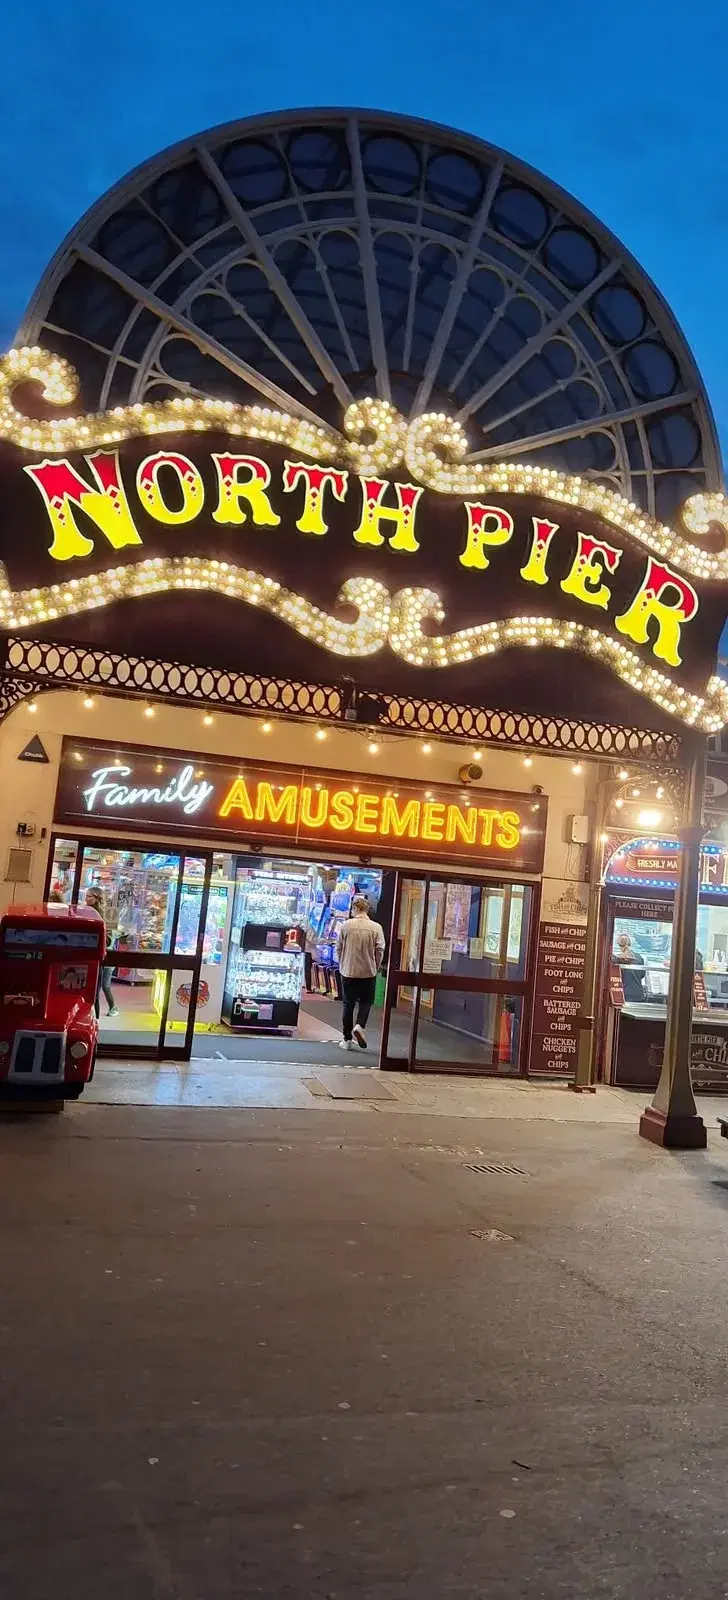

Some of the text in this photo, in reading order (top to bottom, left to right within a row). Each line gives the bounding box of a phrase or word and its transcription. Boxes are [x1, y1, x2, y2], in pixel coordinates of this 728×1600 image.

[24, 448, 699, 667] NORTH PIER
[82, 765, 520, 849] Family AMUSEMENTS
[637, 859, 677, 869] FRESHLY MA
[615, 900, 638, 909] PLEASE
[639, 903, 666, 911] COLLECT
[641, 910, 659, 918] HERE
[544, 926, 560, 934] FISH
[569, 928, 587, 937] CHIP
[540, 940, 566, 950] SAUSAGE
[574, 943, 585, 951] CHI
[544, 955, 556, 963] PIE
[544, 968, 584, 980] FOOT LONG
[552, 985, 574, 994] CHIPS
[543, 999, 581, 1009] BATTERED
[546, 1006, 577, 1016] SAUSAGE
[550, 1022, 572, 1031] CHIPS
[543, 1037, 577, 1046] CHICKEN
[542, 1044, 576, 1054] NUGGETS
[705, 1047, 728, 1064] CHI
[547, 1060, 569, 1069] CHIPS
